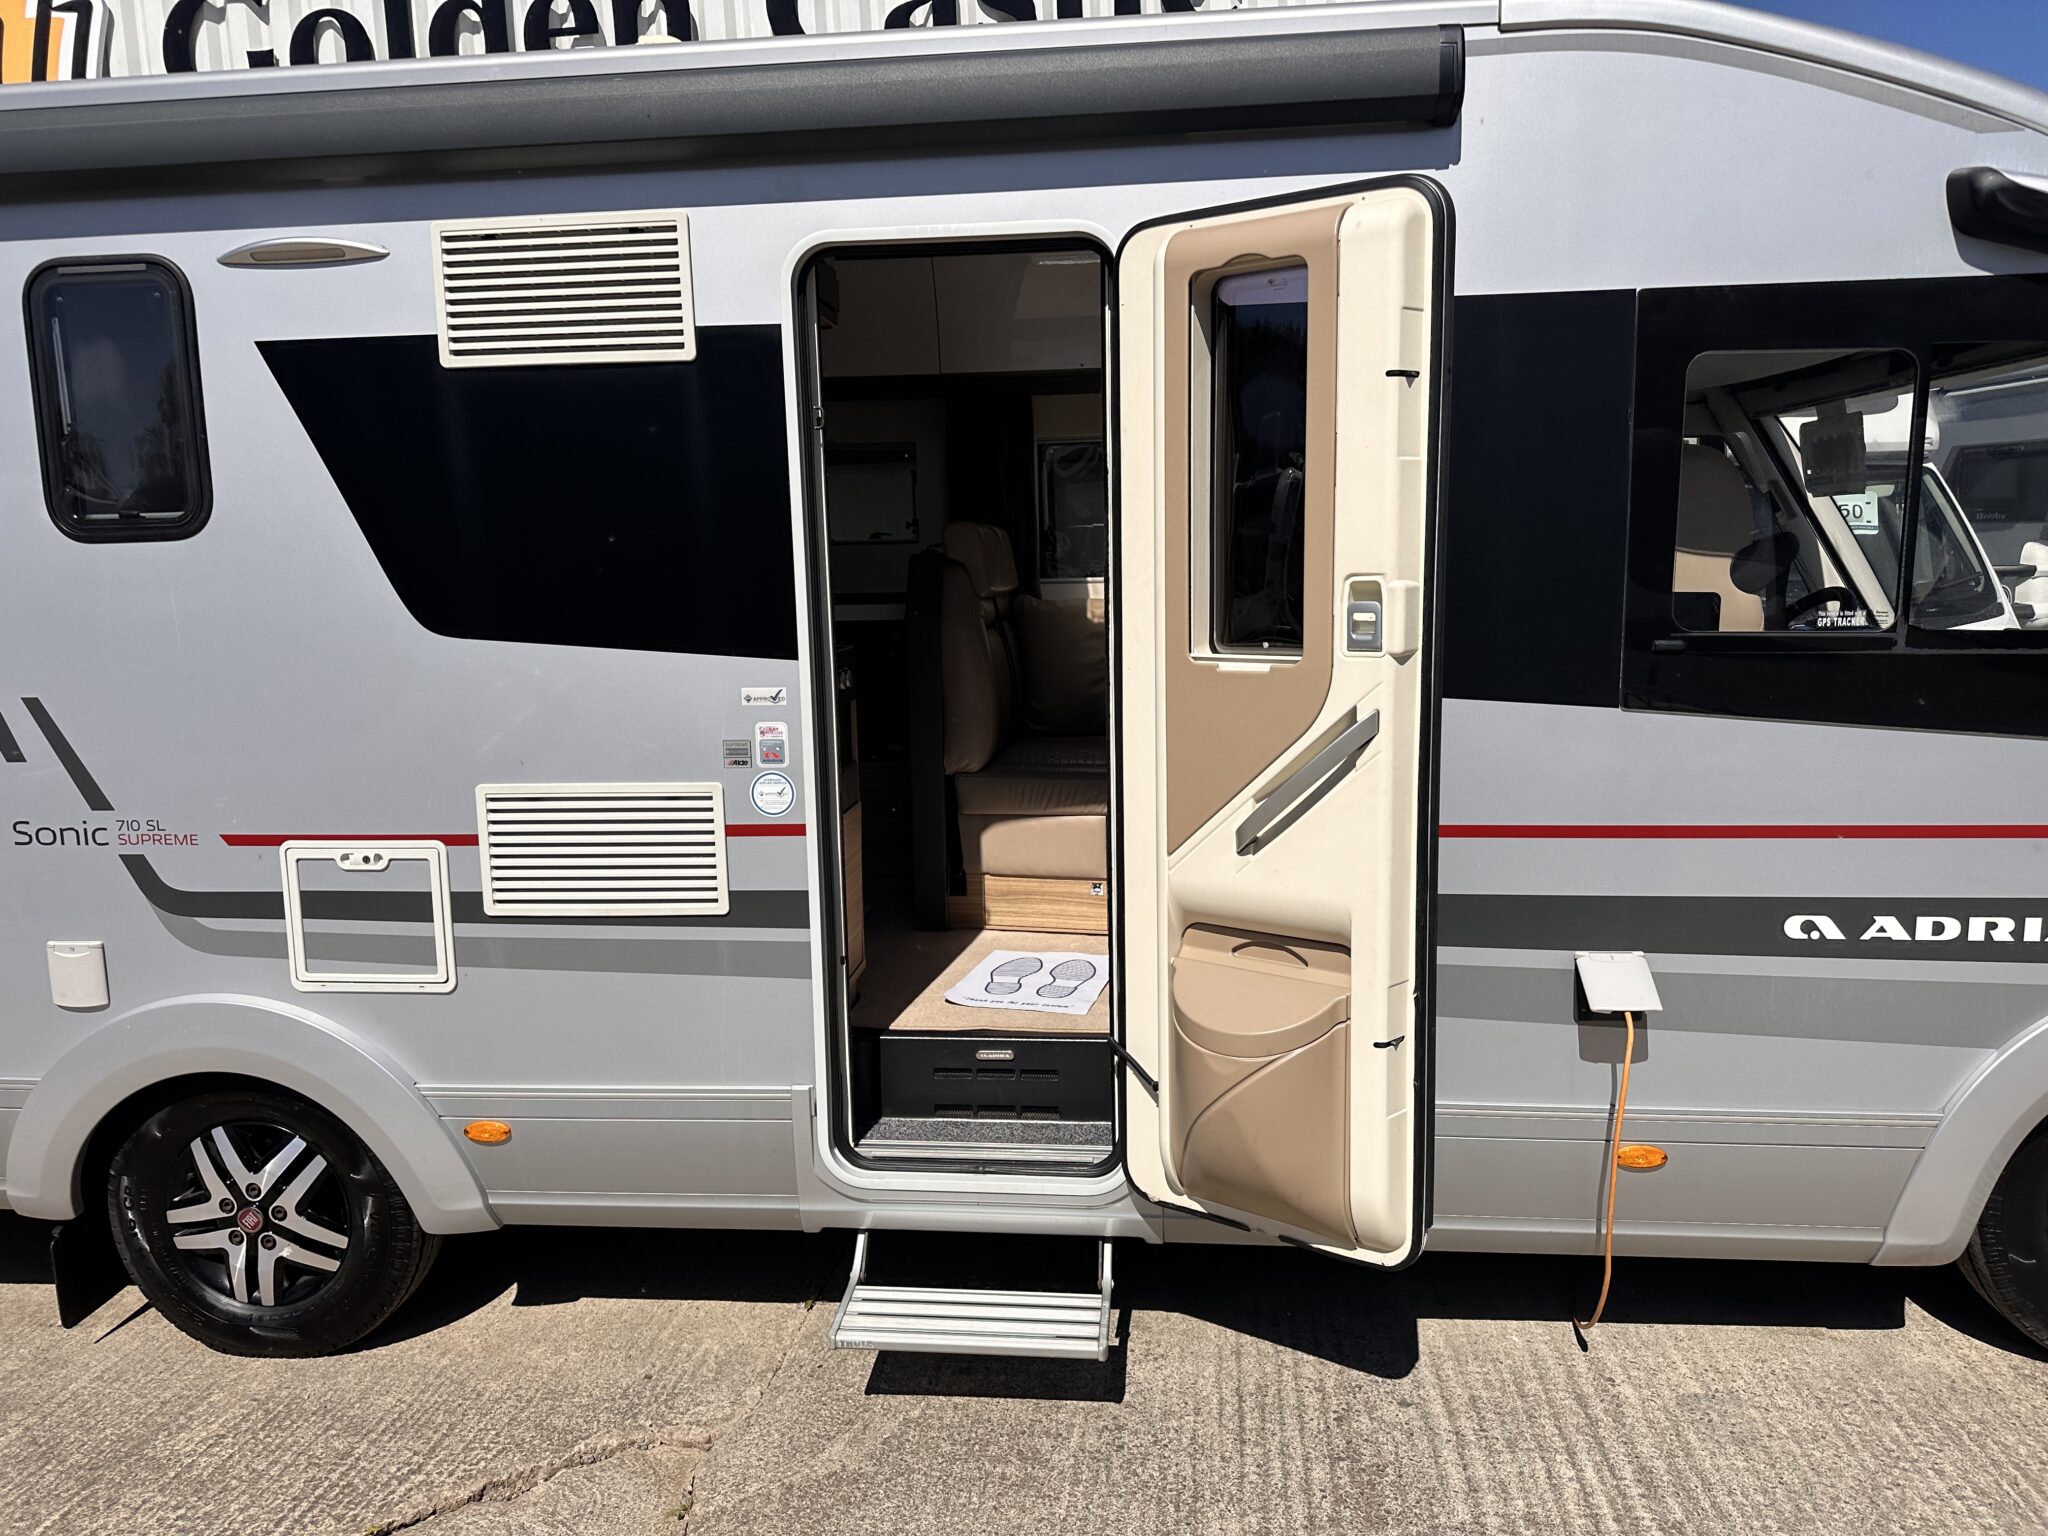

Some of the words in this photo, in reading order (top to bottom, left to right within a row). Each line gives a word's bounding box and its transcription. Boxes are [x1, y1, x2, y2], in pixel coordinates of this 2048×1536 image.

[1817, 617, 1831, 627] GPS
[12, 820, 109, 846] Sonic
[116, 819, 141, 832] 710
[146, 819, 166, 832] SL
[118, 833, 199, 846] SUPREME
[1860, 915, 2048, 942] ADRI
[241, 1211, 259, 1229] FIAT
